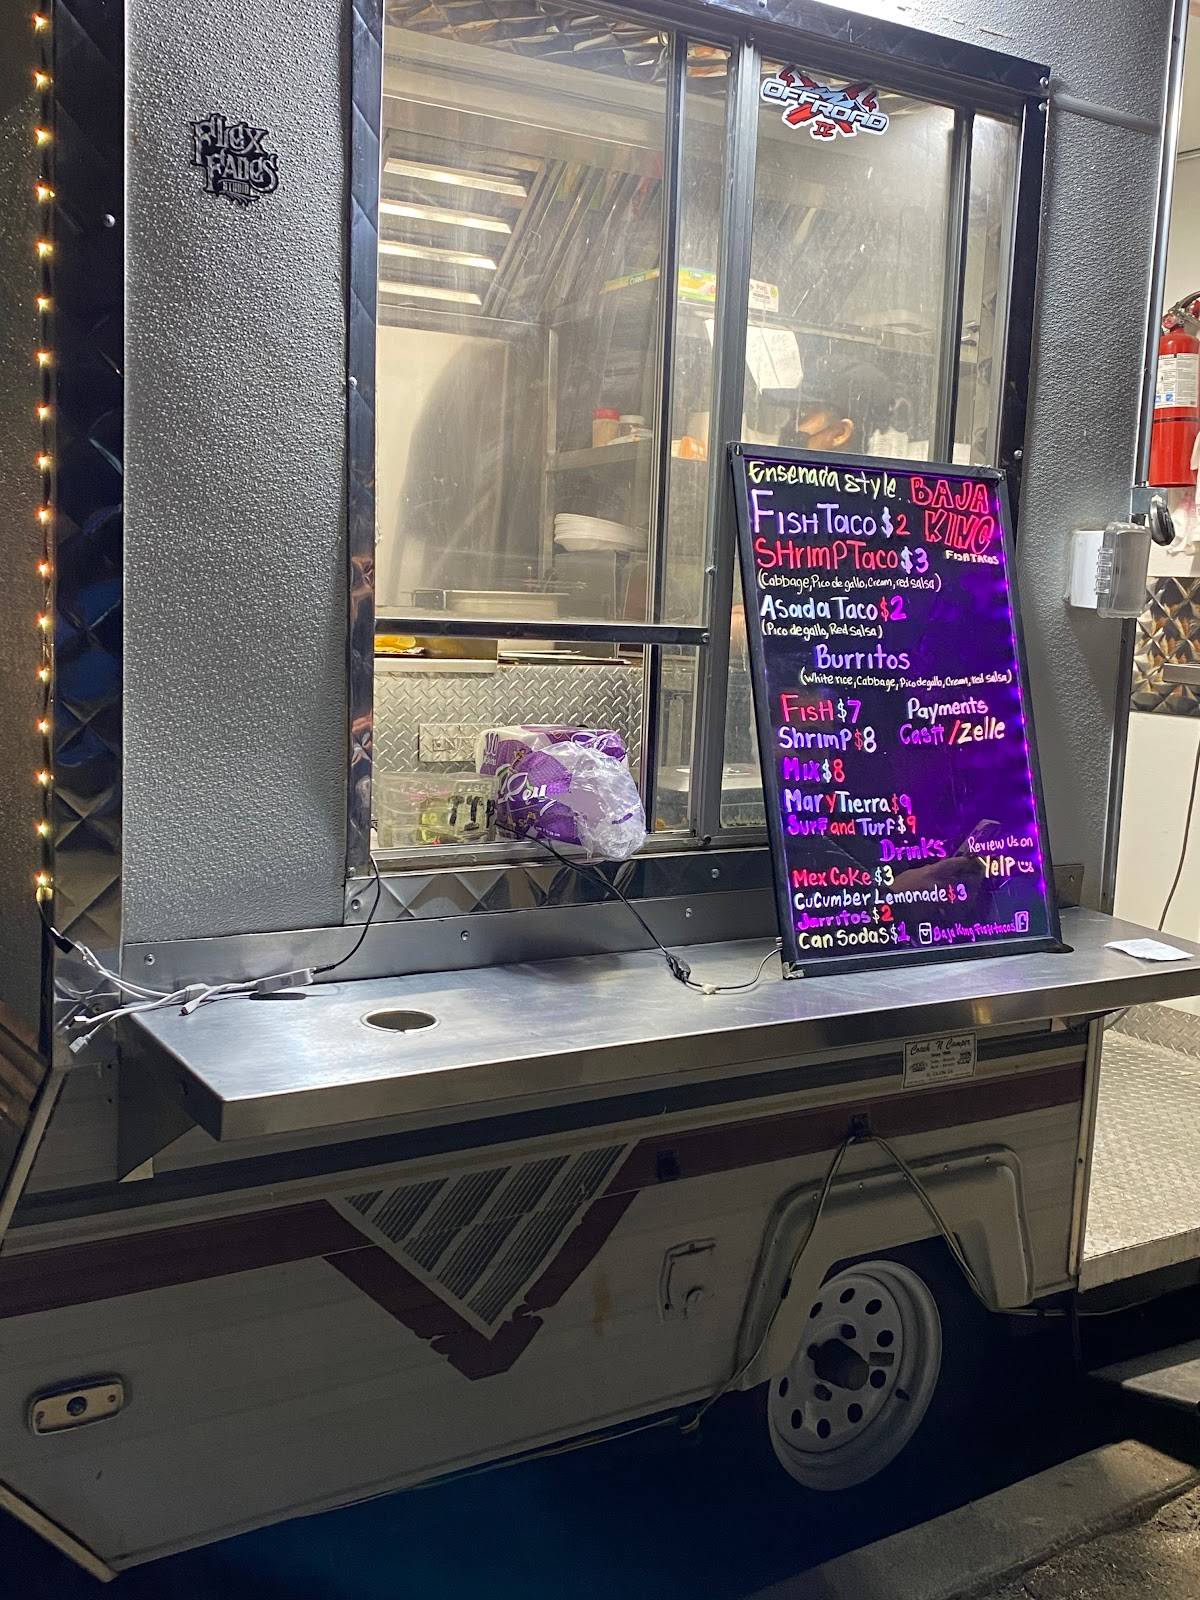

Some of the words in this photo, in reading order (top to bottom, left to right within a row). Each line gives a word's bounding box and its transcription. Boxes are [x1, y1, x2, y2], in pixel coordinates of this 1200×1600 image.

[762, 80, 888, 132] OFFROAD
[749, 461, 840, 492] Ensenada
[910, 477, 989, 514] BAJA
[817, 503, 877, 535] Taco
[881, 506, 911, 538] $2
[924, 508, 994, 555] KING
[846, 540, 899, 570] Taco
[900, 546, 929, 574] $3
[896, 577, 909, 588] red
[760, 594, 831, 621] Asada
[830, 596, 879, 621] Taco
[880, 595, 907, 622] $2
[828, 622, 849, 635] Red
[815, 643, 911, 670] Burritos
[836, 698, 862, 724] $7
[907, 696, 989, 725] Payments
[854, 725, 877, 753] $8
[821, 758, 846, 783] $8
[784, 788, 824, 813] Mar
[834, 790, 892, 813] Tierra
[891, 793, 912, 816] $9
[829, 819, 856, 836] and
[897, 814, 917, 836] $9
[1020, 837, 1034, 848] on
[791, 870, 828, 889] Mex
[874, 864, 895, 886] $3
[874, 883, 948, 905] Lemonade
[947, 882, 968, 904] $3
[872, 904, 895, 924] $2
[798, 932, 834, 950] Can
[890, 921, 911, 944] $1
